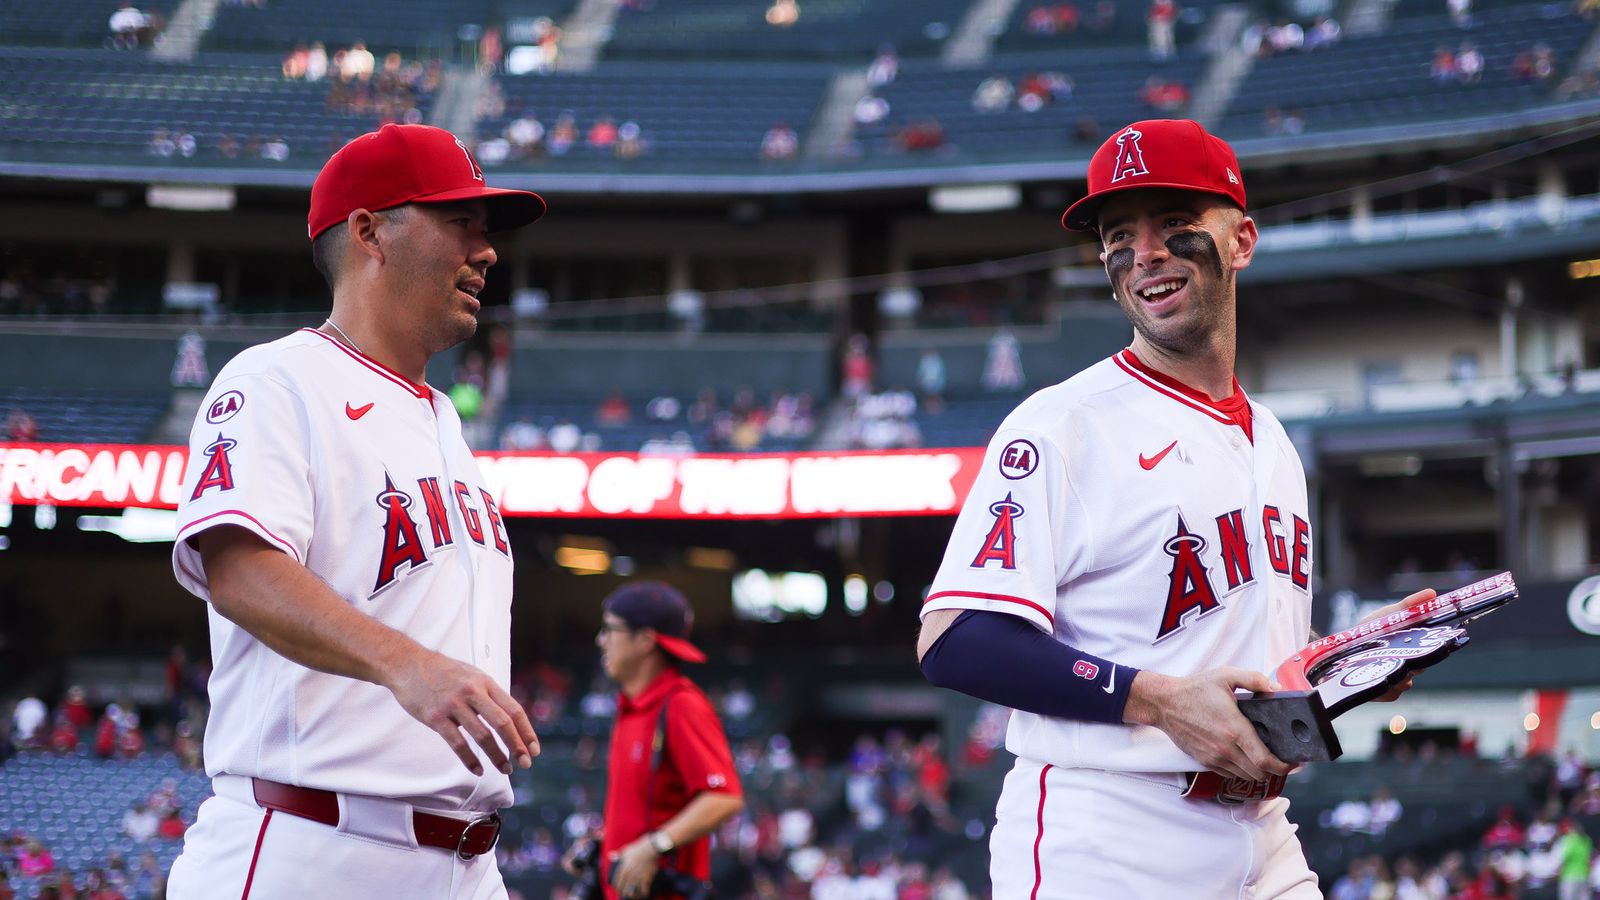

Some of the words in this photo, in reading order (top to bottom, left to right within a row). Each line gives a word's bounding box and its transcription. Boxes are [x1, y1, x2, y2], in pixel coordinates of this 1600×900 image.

[1111, 127, 1150, 183] A
[211, 397, 238, 418] GA
[0, 448, 161, 502] RICAN
[189, 432, 238, 502] A
[1003, 447, 1030, 472] GA
[970, 491, 1025, 570] A
[1312, 620, 1384, 650] PLAYER
[1388, 609, 1413, 625] OF
[1416, 594, 1452, 615] THE
[1454, 573, 1512, 600] WEEK
[1073, 660, 1099, 680] 9
[1363, 648, 1424, 658] AMERICAN
